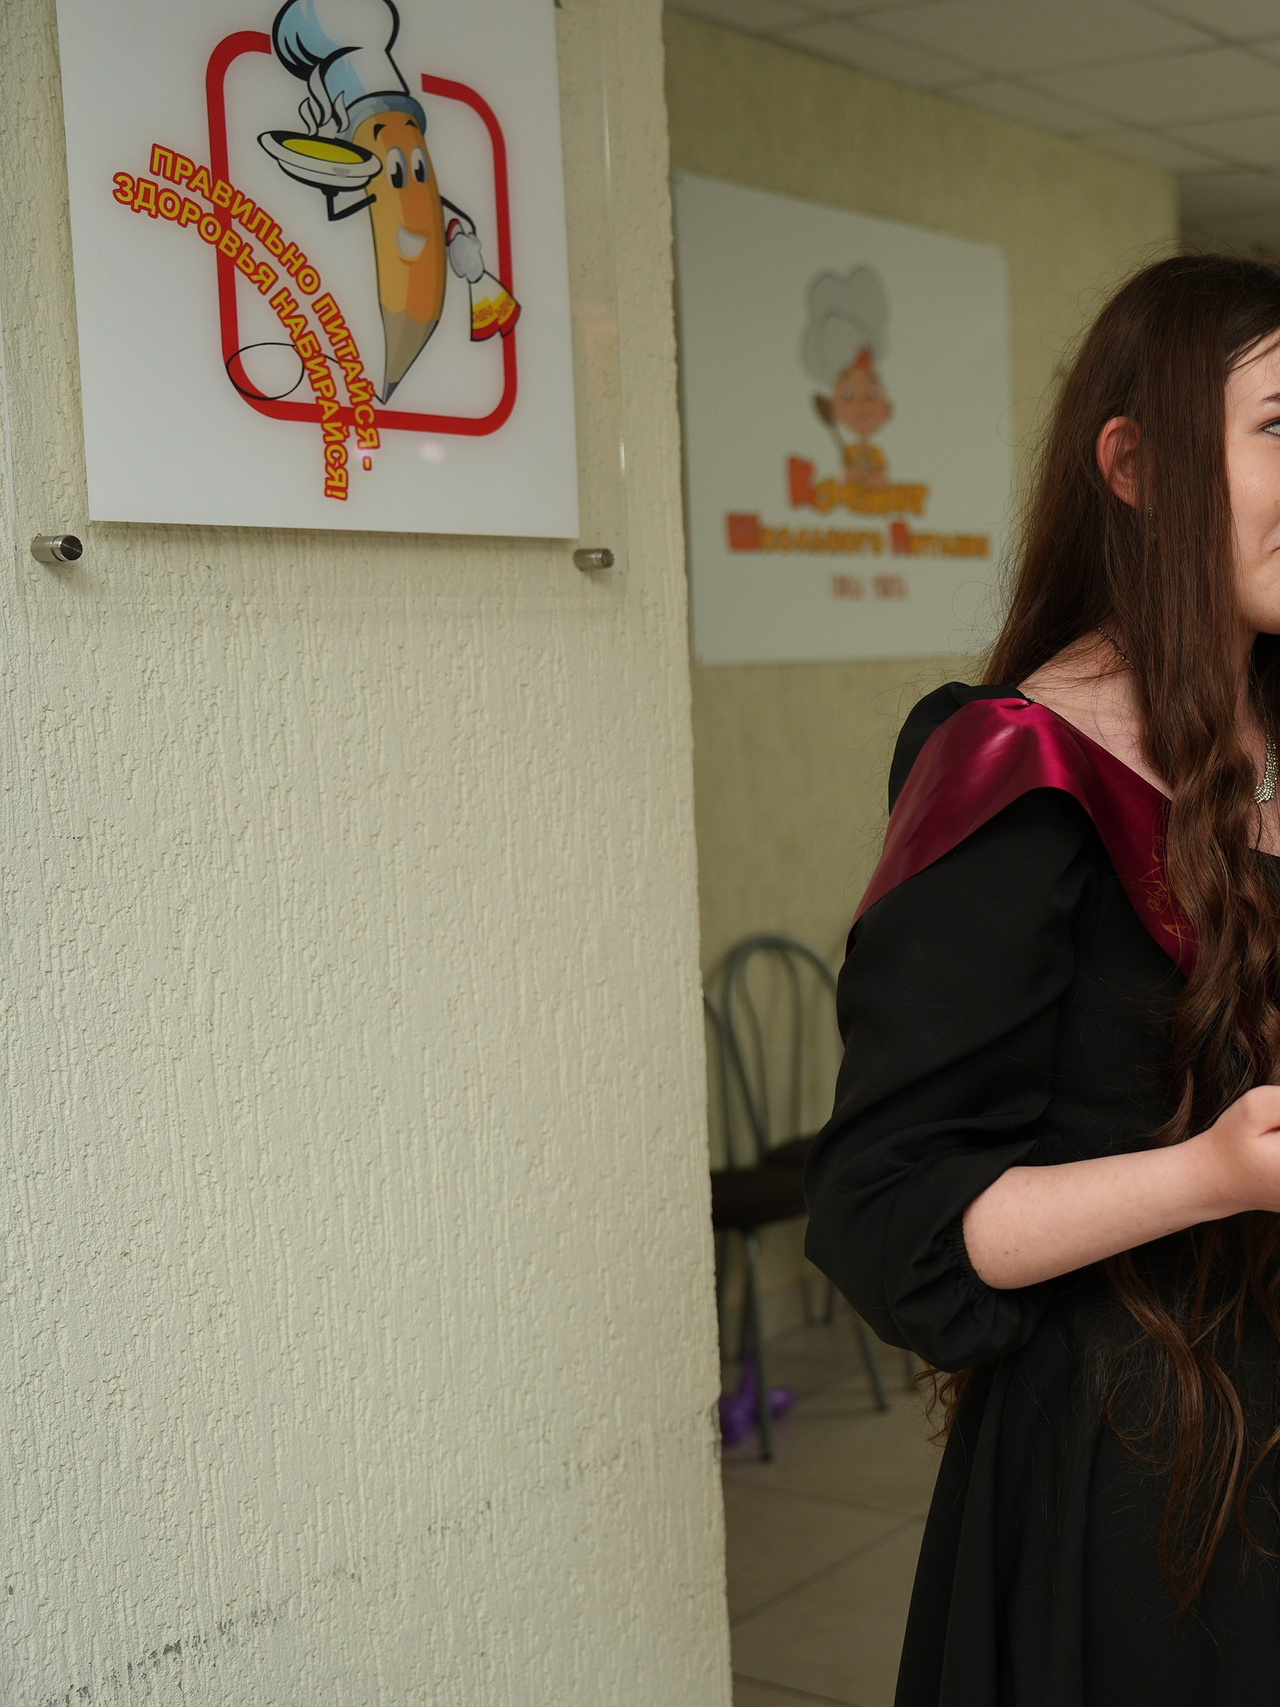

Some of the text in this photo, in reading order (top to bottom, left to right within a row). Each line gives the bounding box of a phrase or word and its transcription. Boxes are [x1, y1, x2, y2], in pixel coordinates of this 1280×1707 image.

[113, 172, 350, 501] ЗДОРОВЬЯ НАБИРАЙСЯ!
[149, 144, 320, 296] ПРАВИЛЬНО
[311, 293, 381, 449] ПИТАЙСЯ
